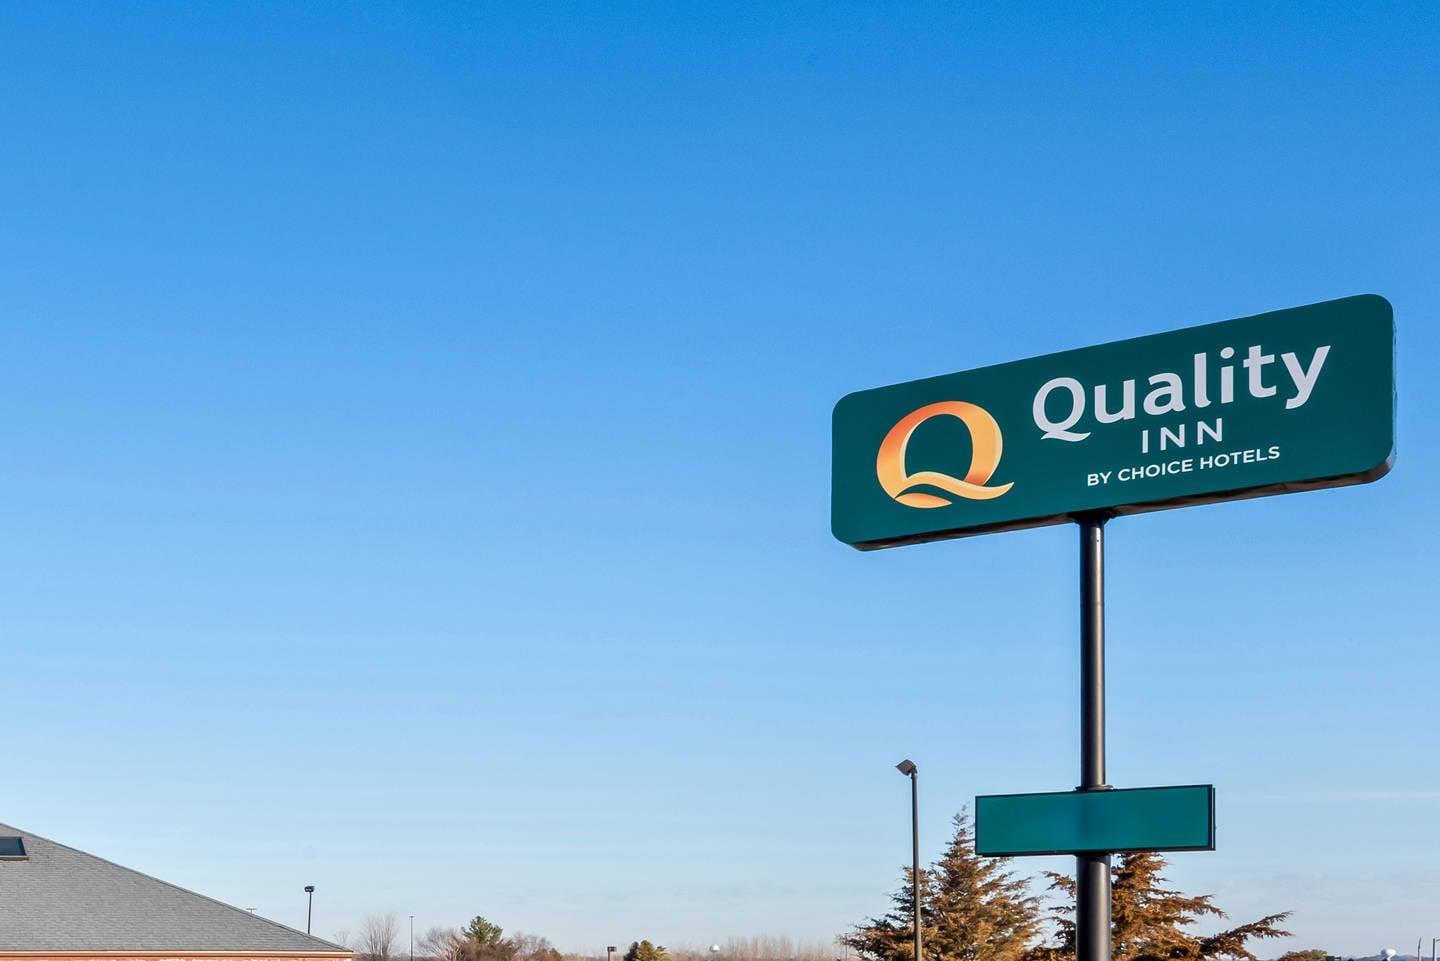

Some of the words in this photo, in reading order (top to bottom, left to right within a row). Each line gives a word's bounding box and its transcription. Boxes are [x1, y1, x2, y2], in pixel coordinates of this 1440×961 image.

[1032, 344, 1331, 442] Quality
[875, 400, 1015, 509] Q
[1087, 471, 1112, 487] BY
[1117, 458, 1194, 482] CHOICE
[1199, 446, 1281, 470] HOTELS
[1142, 417, 1224, 454] INN
